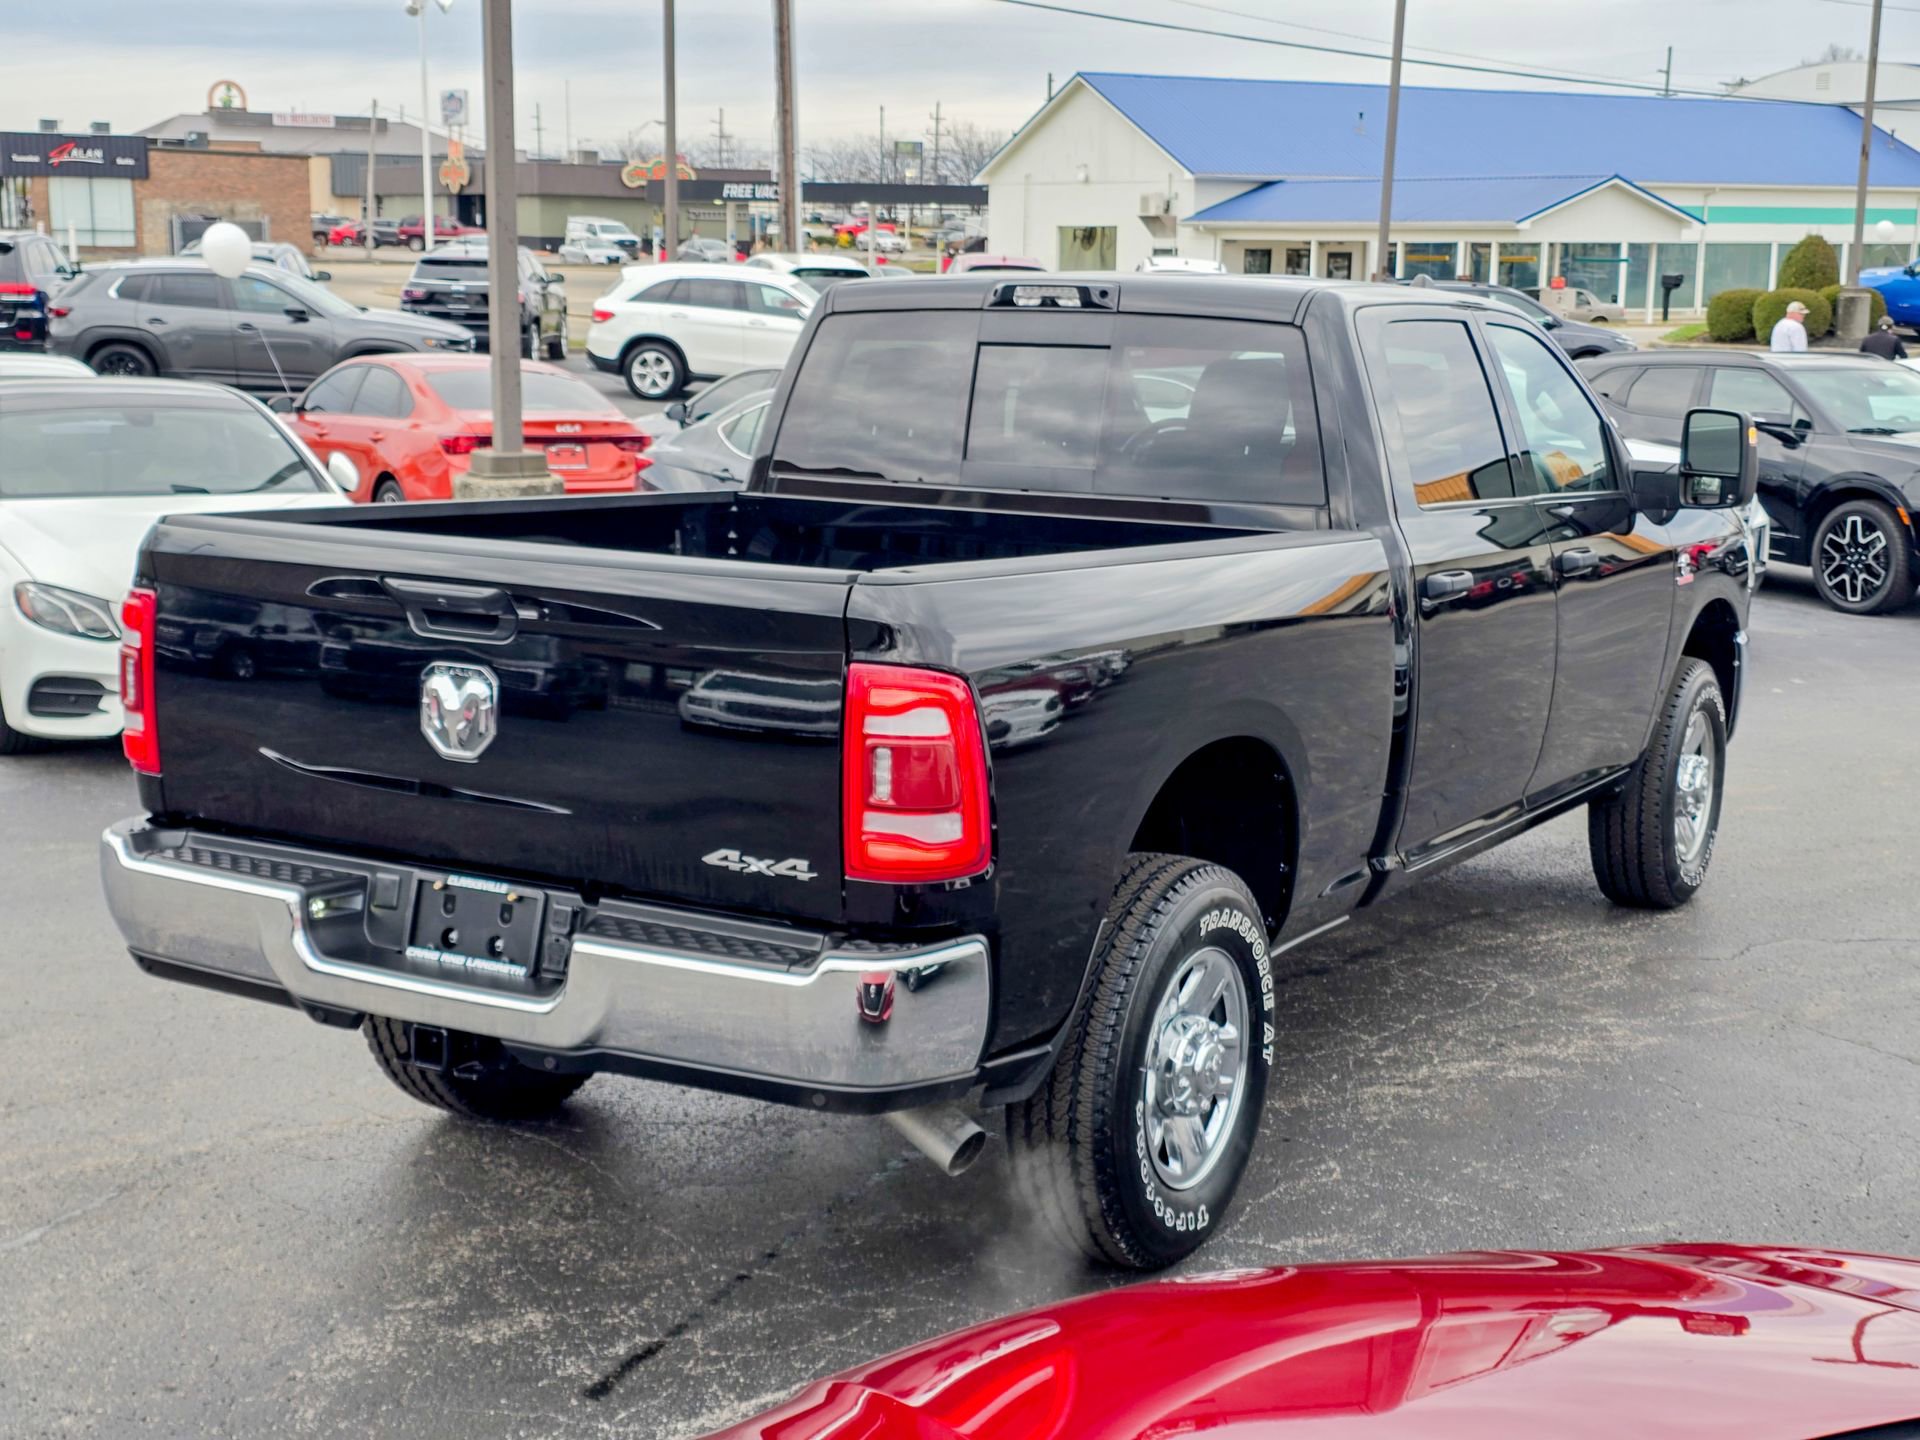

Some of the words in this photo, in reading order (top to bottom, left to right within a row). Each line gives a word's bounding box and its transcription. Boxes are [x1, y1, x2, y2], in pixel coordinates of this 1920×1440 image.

[722, 183, 754, 198] FREE
[701, 848, 818, 882] 4x4
[440, 952, 466, 965] AND
[1199, 908, 1275, 1011] TRANSFORCE
[1262, 1022, 1275, 1066] AT
